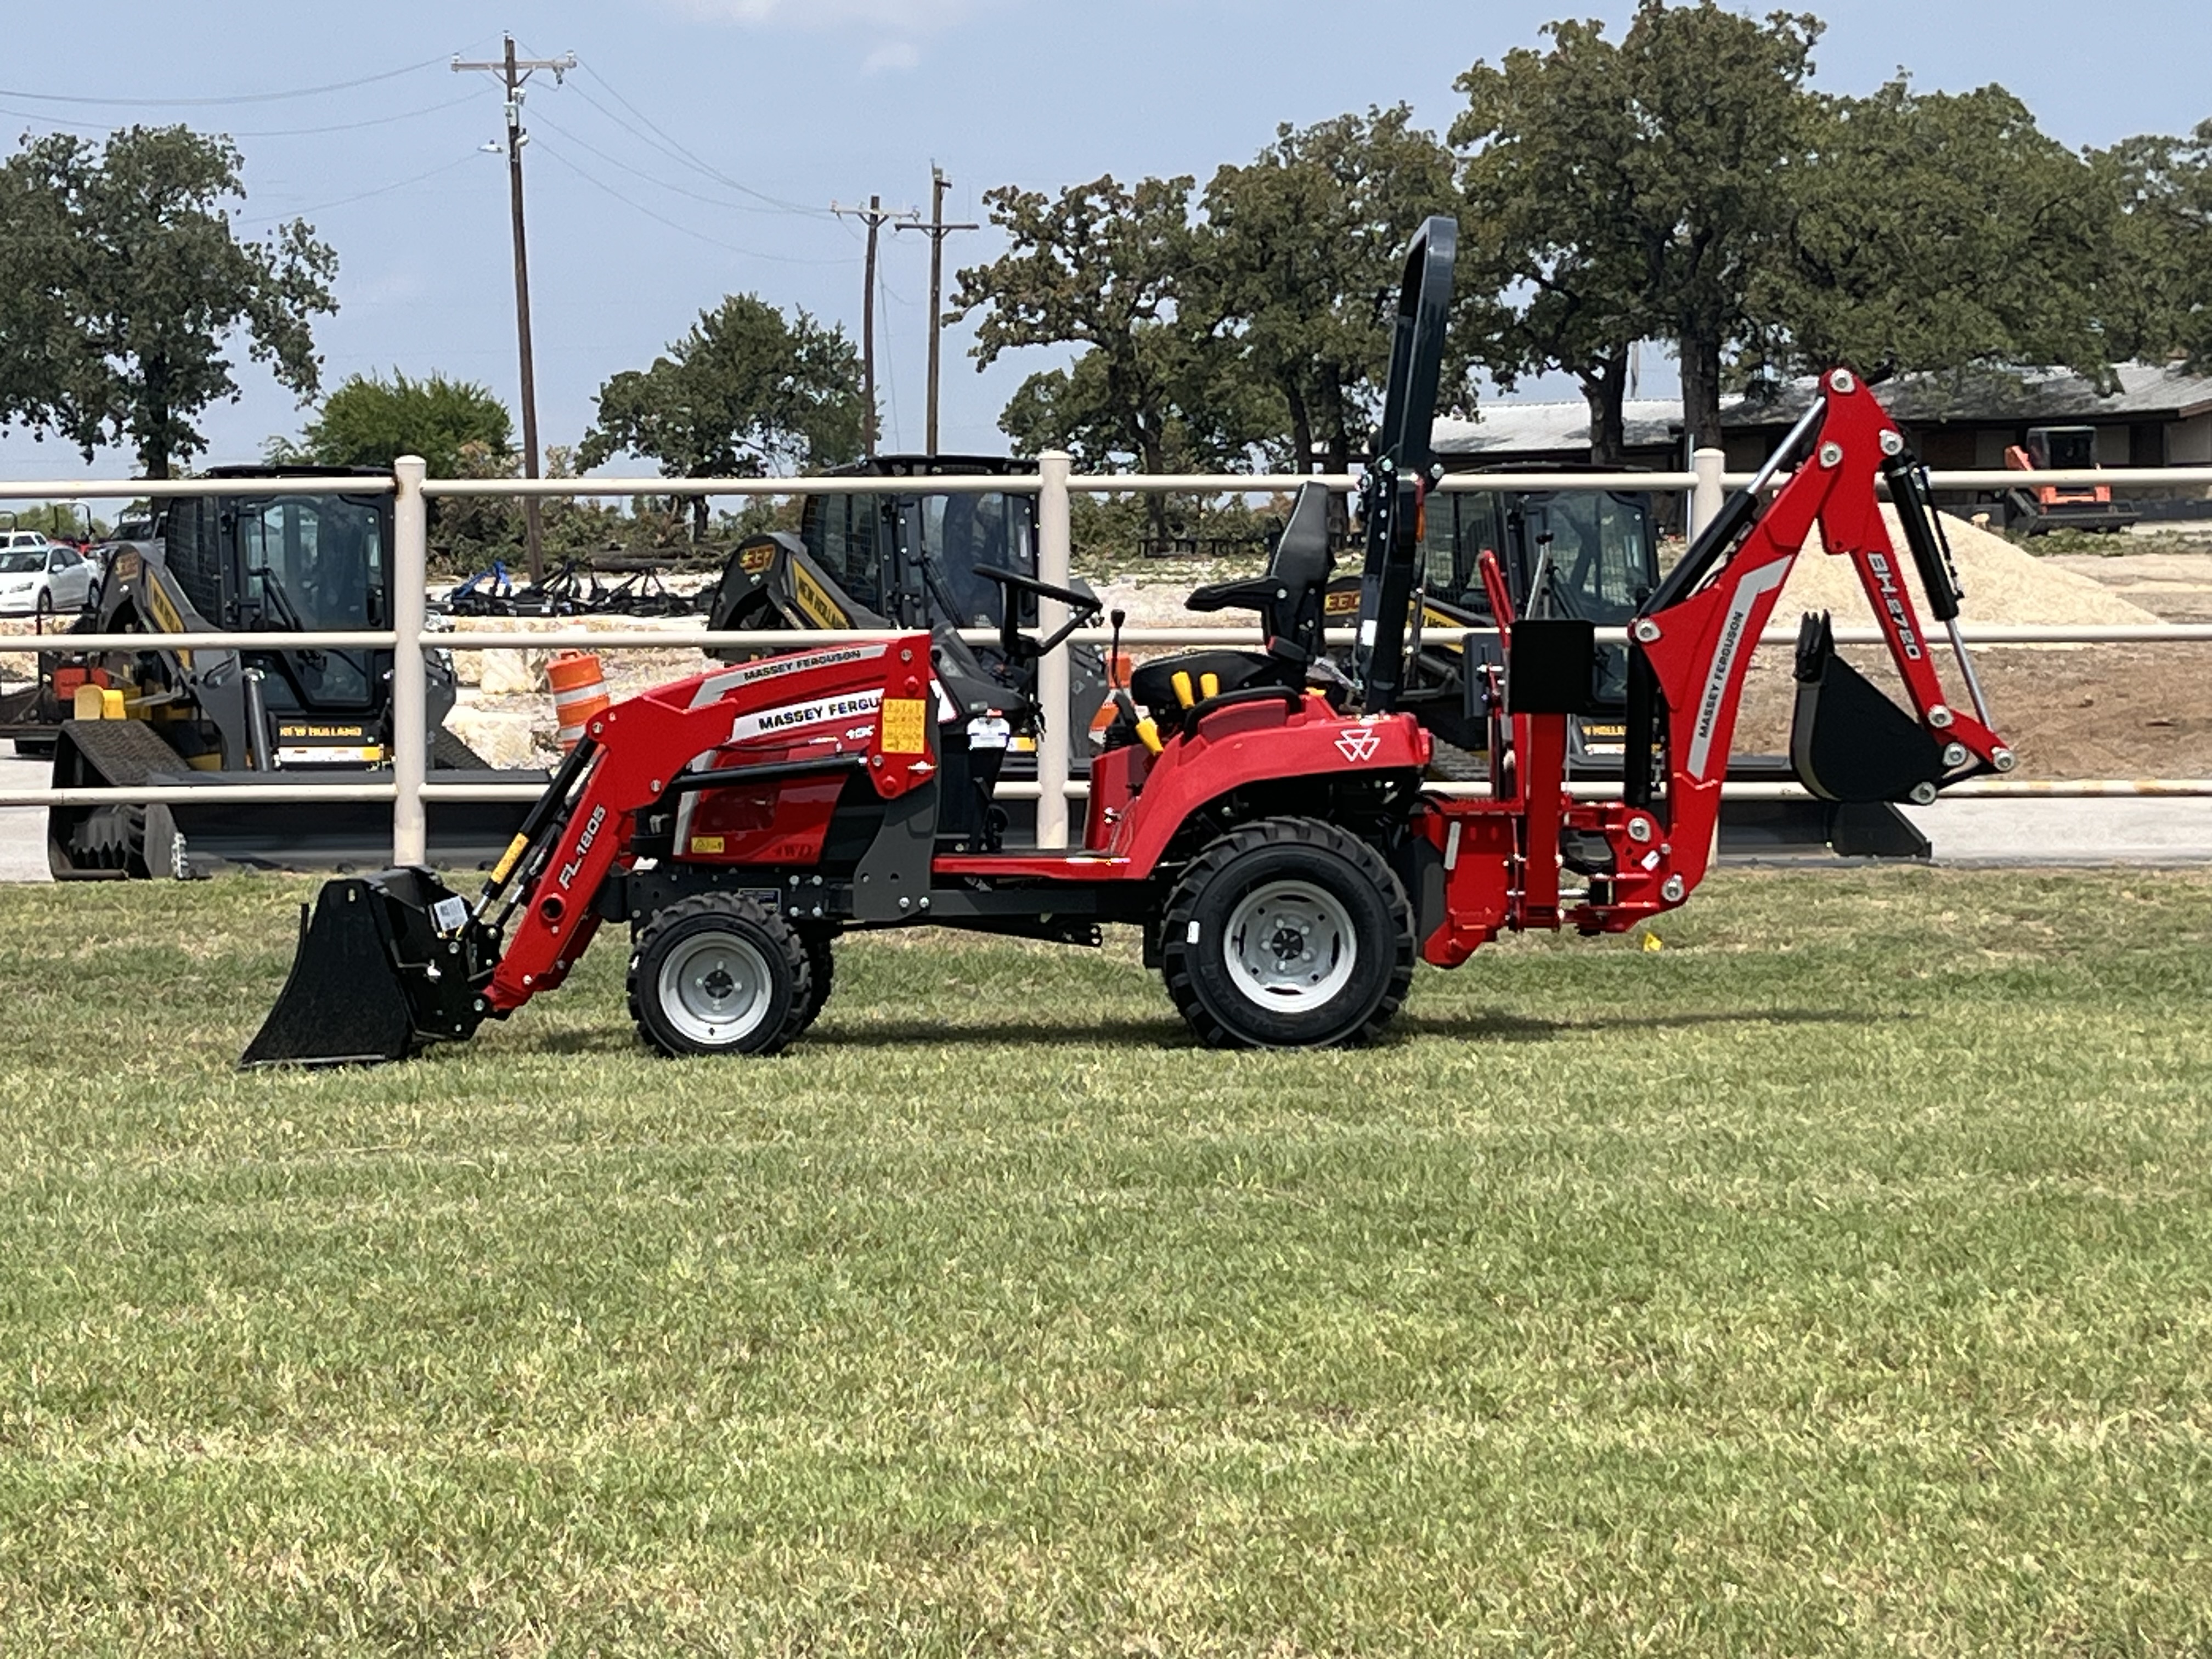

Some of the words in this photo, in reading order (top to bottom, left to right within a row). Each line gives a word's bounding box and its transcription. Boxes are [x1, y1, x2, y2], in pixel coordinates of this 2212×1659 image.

[744, 662, 793, 681] MASSEY
[797, 650, 861, 669] FERGUSON
[1699, 684, 1720, 738] MASSEY
[1714, 611, 1743, 681] FERGUSON
[758, 706, 823, 730] MASSEY
